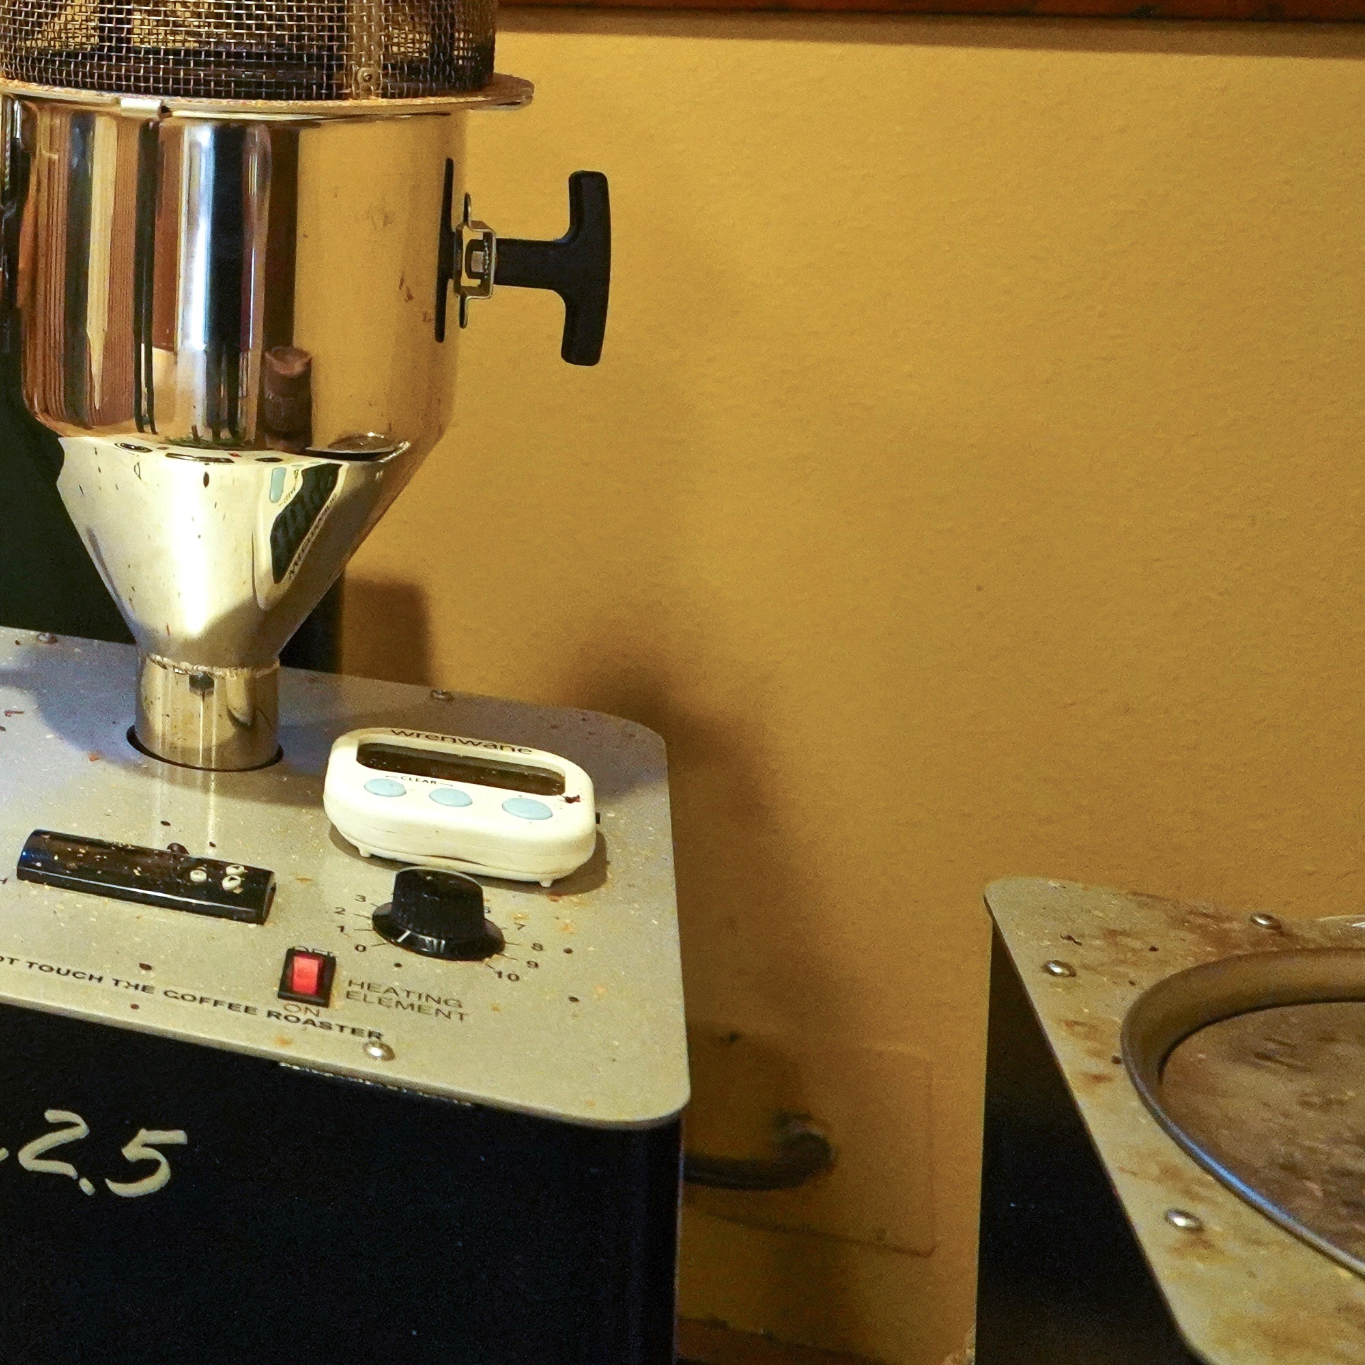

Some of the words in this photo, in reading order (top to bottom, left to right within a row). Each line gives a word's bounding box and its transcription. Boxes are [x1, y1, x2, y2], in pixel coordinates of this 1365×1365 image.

[400, 775, 438, 786] CLEAR
[354, 894, 367, 903] 3
[334, 907, 347, 915] 2
[354, 943, 367, 953] 0
[526, 960, 539, 969] 9
[495, 970, 520, 982] 10
[347, 978, 464, 1009] HEATING
[26, 960, 103, 984] TOUCH
[111, 977, 155, 995] THE
[163, 990, 258, 1016] COFFEE
[267, 1009, 384, 1041] ROASTER
[346, 990, 469, 1023] ELEMENT
[283, 1003, 320, 1018] ON
[17, 1108, 188, 1198] 2.5
